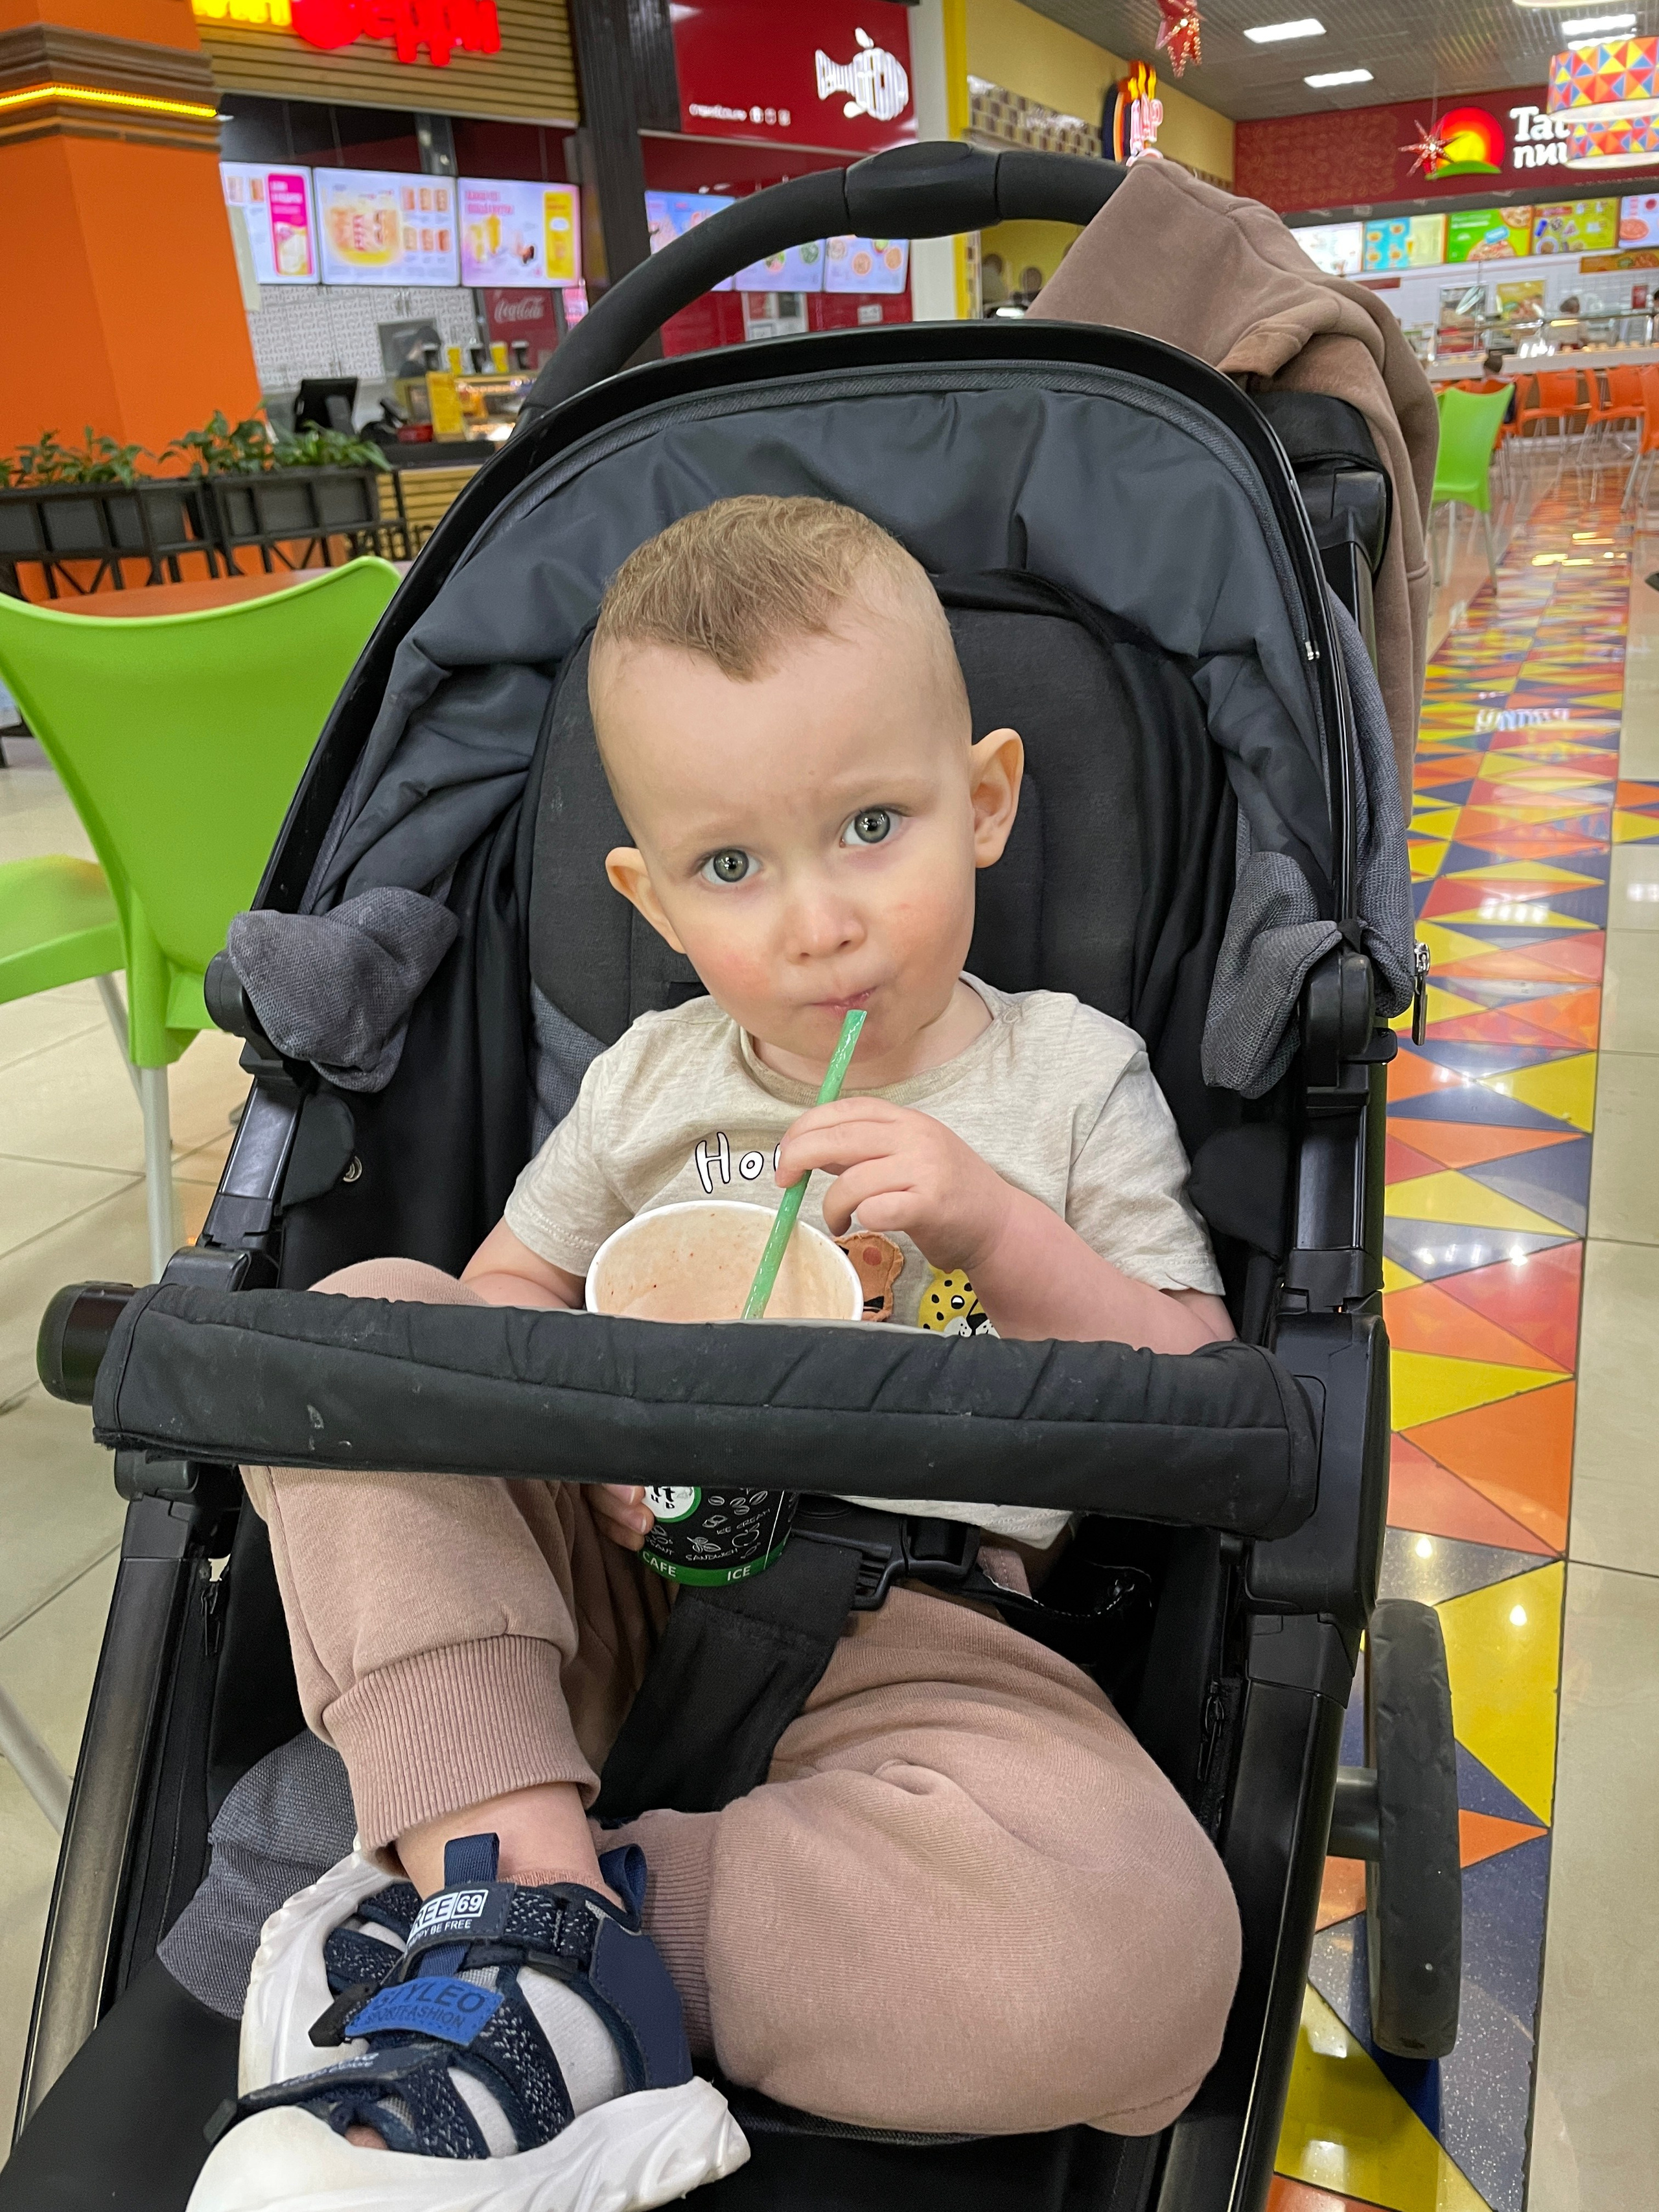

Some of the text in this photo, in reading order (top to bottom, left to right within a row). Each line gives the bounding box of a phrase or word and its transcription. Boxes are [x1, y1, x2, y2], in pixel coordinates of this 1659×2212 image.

[695, 1131, 781, 1194] Ho
[642, 1550, 677, 1578] CAFE
[685, 1548, 738, 1561] SANDWICH
[726, 1565, 751, 1581] ICE
[413, 1894, 483, 1932] REE 69
[430, 1922, 443, 1935] BE
[444, 1918, 472, 1931] FREE
